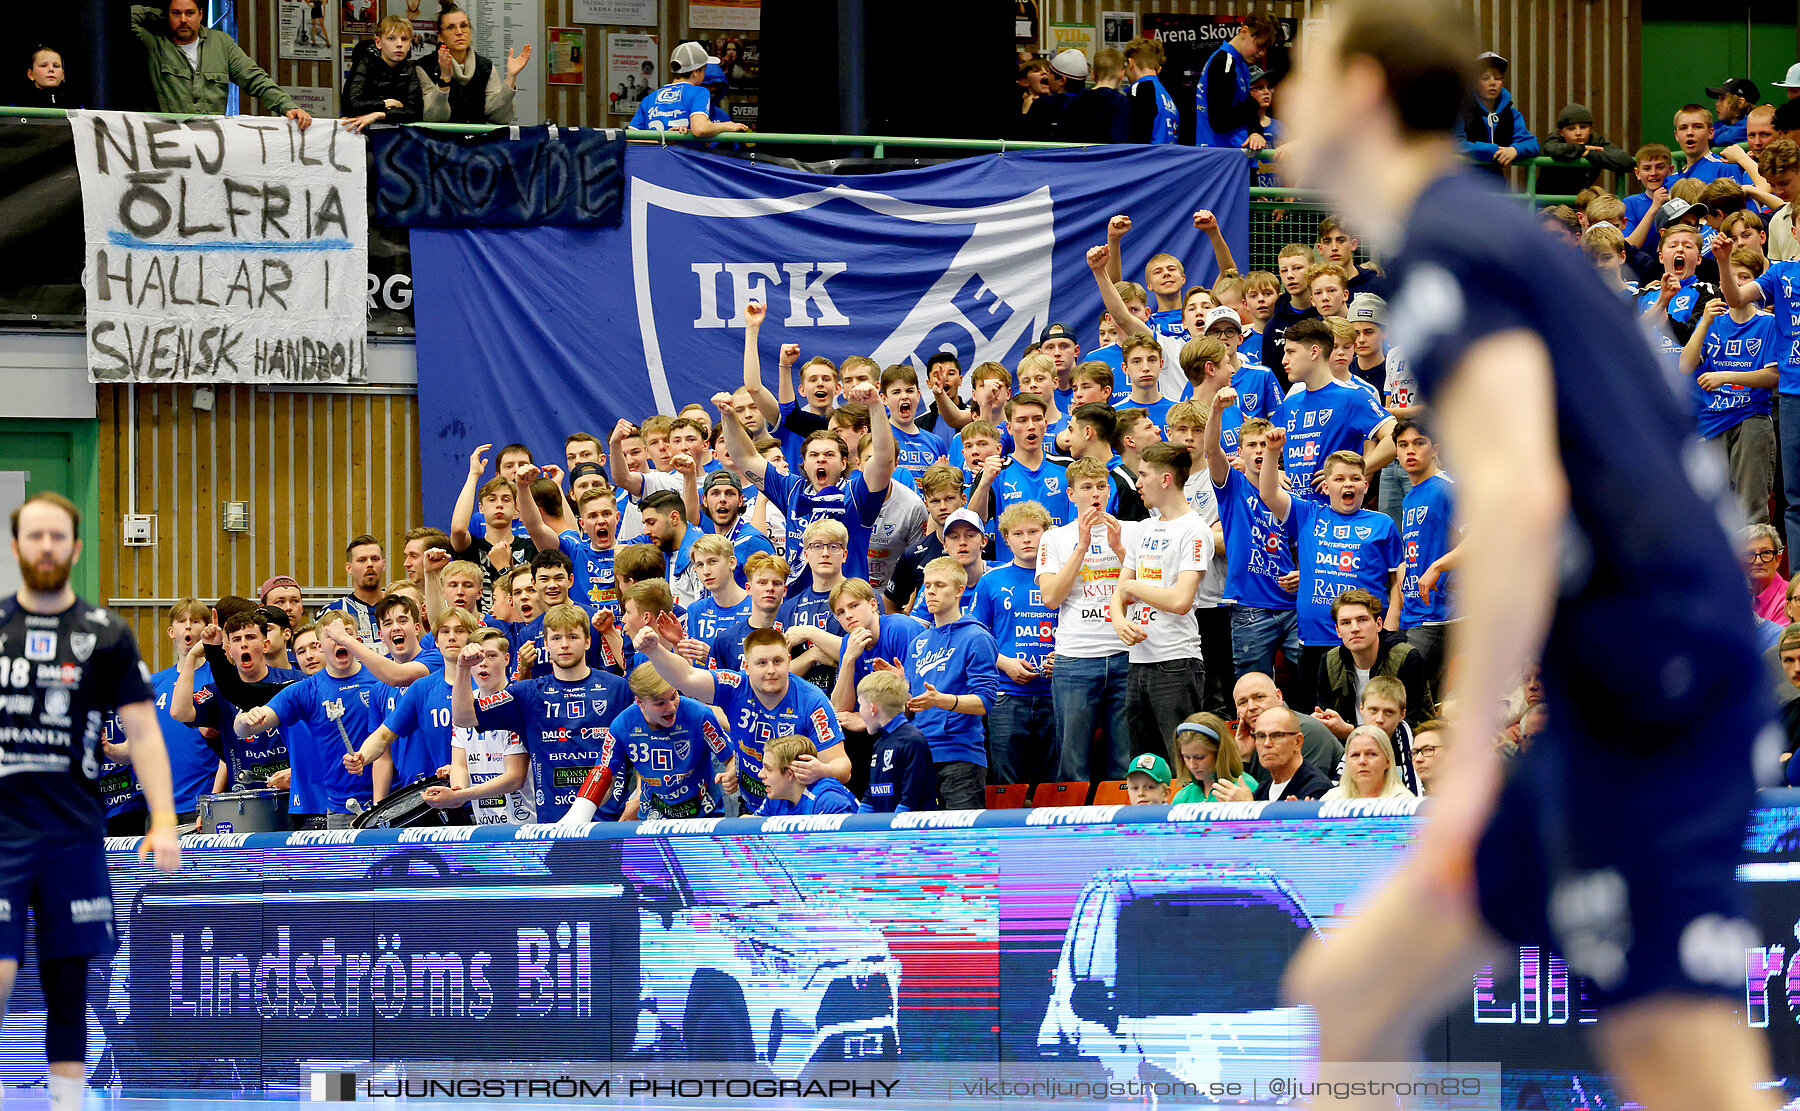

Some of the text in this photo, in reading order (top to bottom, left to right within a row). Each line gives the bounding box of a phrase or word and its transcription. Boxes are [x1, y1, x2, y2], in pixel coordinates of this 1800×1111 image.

[1054, 28, 1091, 42] Villa
[1153, 29, 1196, 42] Arena
[1192, 41, 1220, 49] Evenem
[93, 115, 225, 176] NEJ
[96, 248, 331, 311] HALLAR I
[691, 261, 851, 329] IFK
[91, 320, 244, 381] SVENSK
[1707, 342, 1721, 358] 77
[1289, 444, 1321, 458] DALOC
[1315, 552, 1361, 569] DALOC
[1003, 596, 1011, 611] 6
[794, 611, 808, 627] 19
[698, 619, 716, 638] 15
[155, 692, 168, 710] 4
[387, 697, 395, 711] 9
[544, 700, 561, 718] 77
[430, 707, 450, 728] 10
[738, 708, 758, 733] 37
[813, 709, 832, 741] MAXI
[542, 730, 572, 739] DALOC
[703, 721, 726, 752] MAXI
[628, 742, 650, 763] 33
[169, 921, 592, 1019] Lindströms Bil
